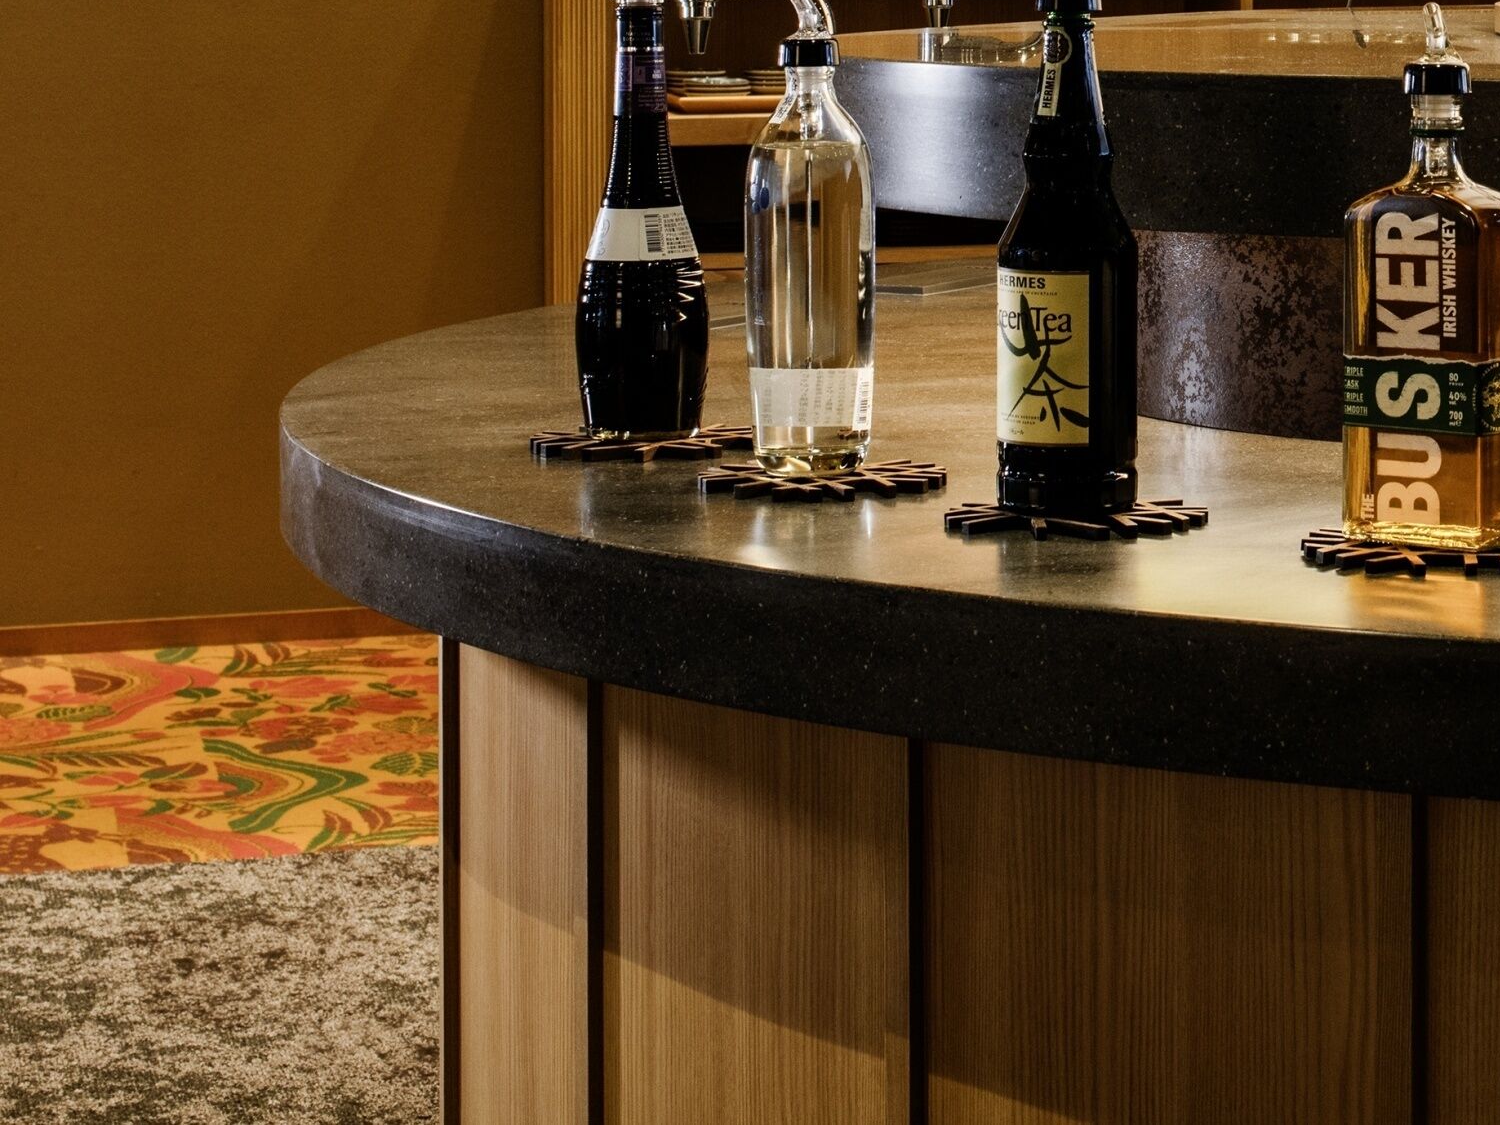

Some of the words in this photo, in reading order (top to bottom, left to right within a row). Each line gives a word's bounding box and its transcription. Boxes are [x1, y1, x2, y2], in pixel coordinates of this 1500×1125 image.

[1042, 69, 1056, 108] HERMES
[1442, 217, 1456, 289] WHISKEY
[1030, 307, 1072, 333] Tea
[1442, 295, 1457, 337] IRISH
[1375, 212, 1442, 525] BUSKER
[1448, 391, 1467, 402] 40%
[1448, 410, 1464, 420] 700
[1361, 493, 1375, 520] THE
